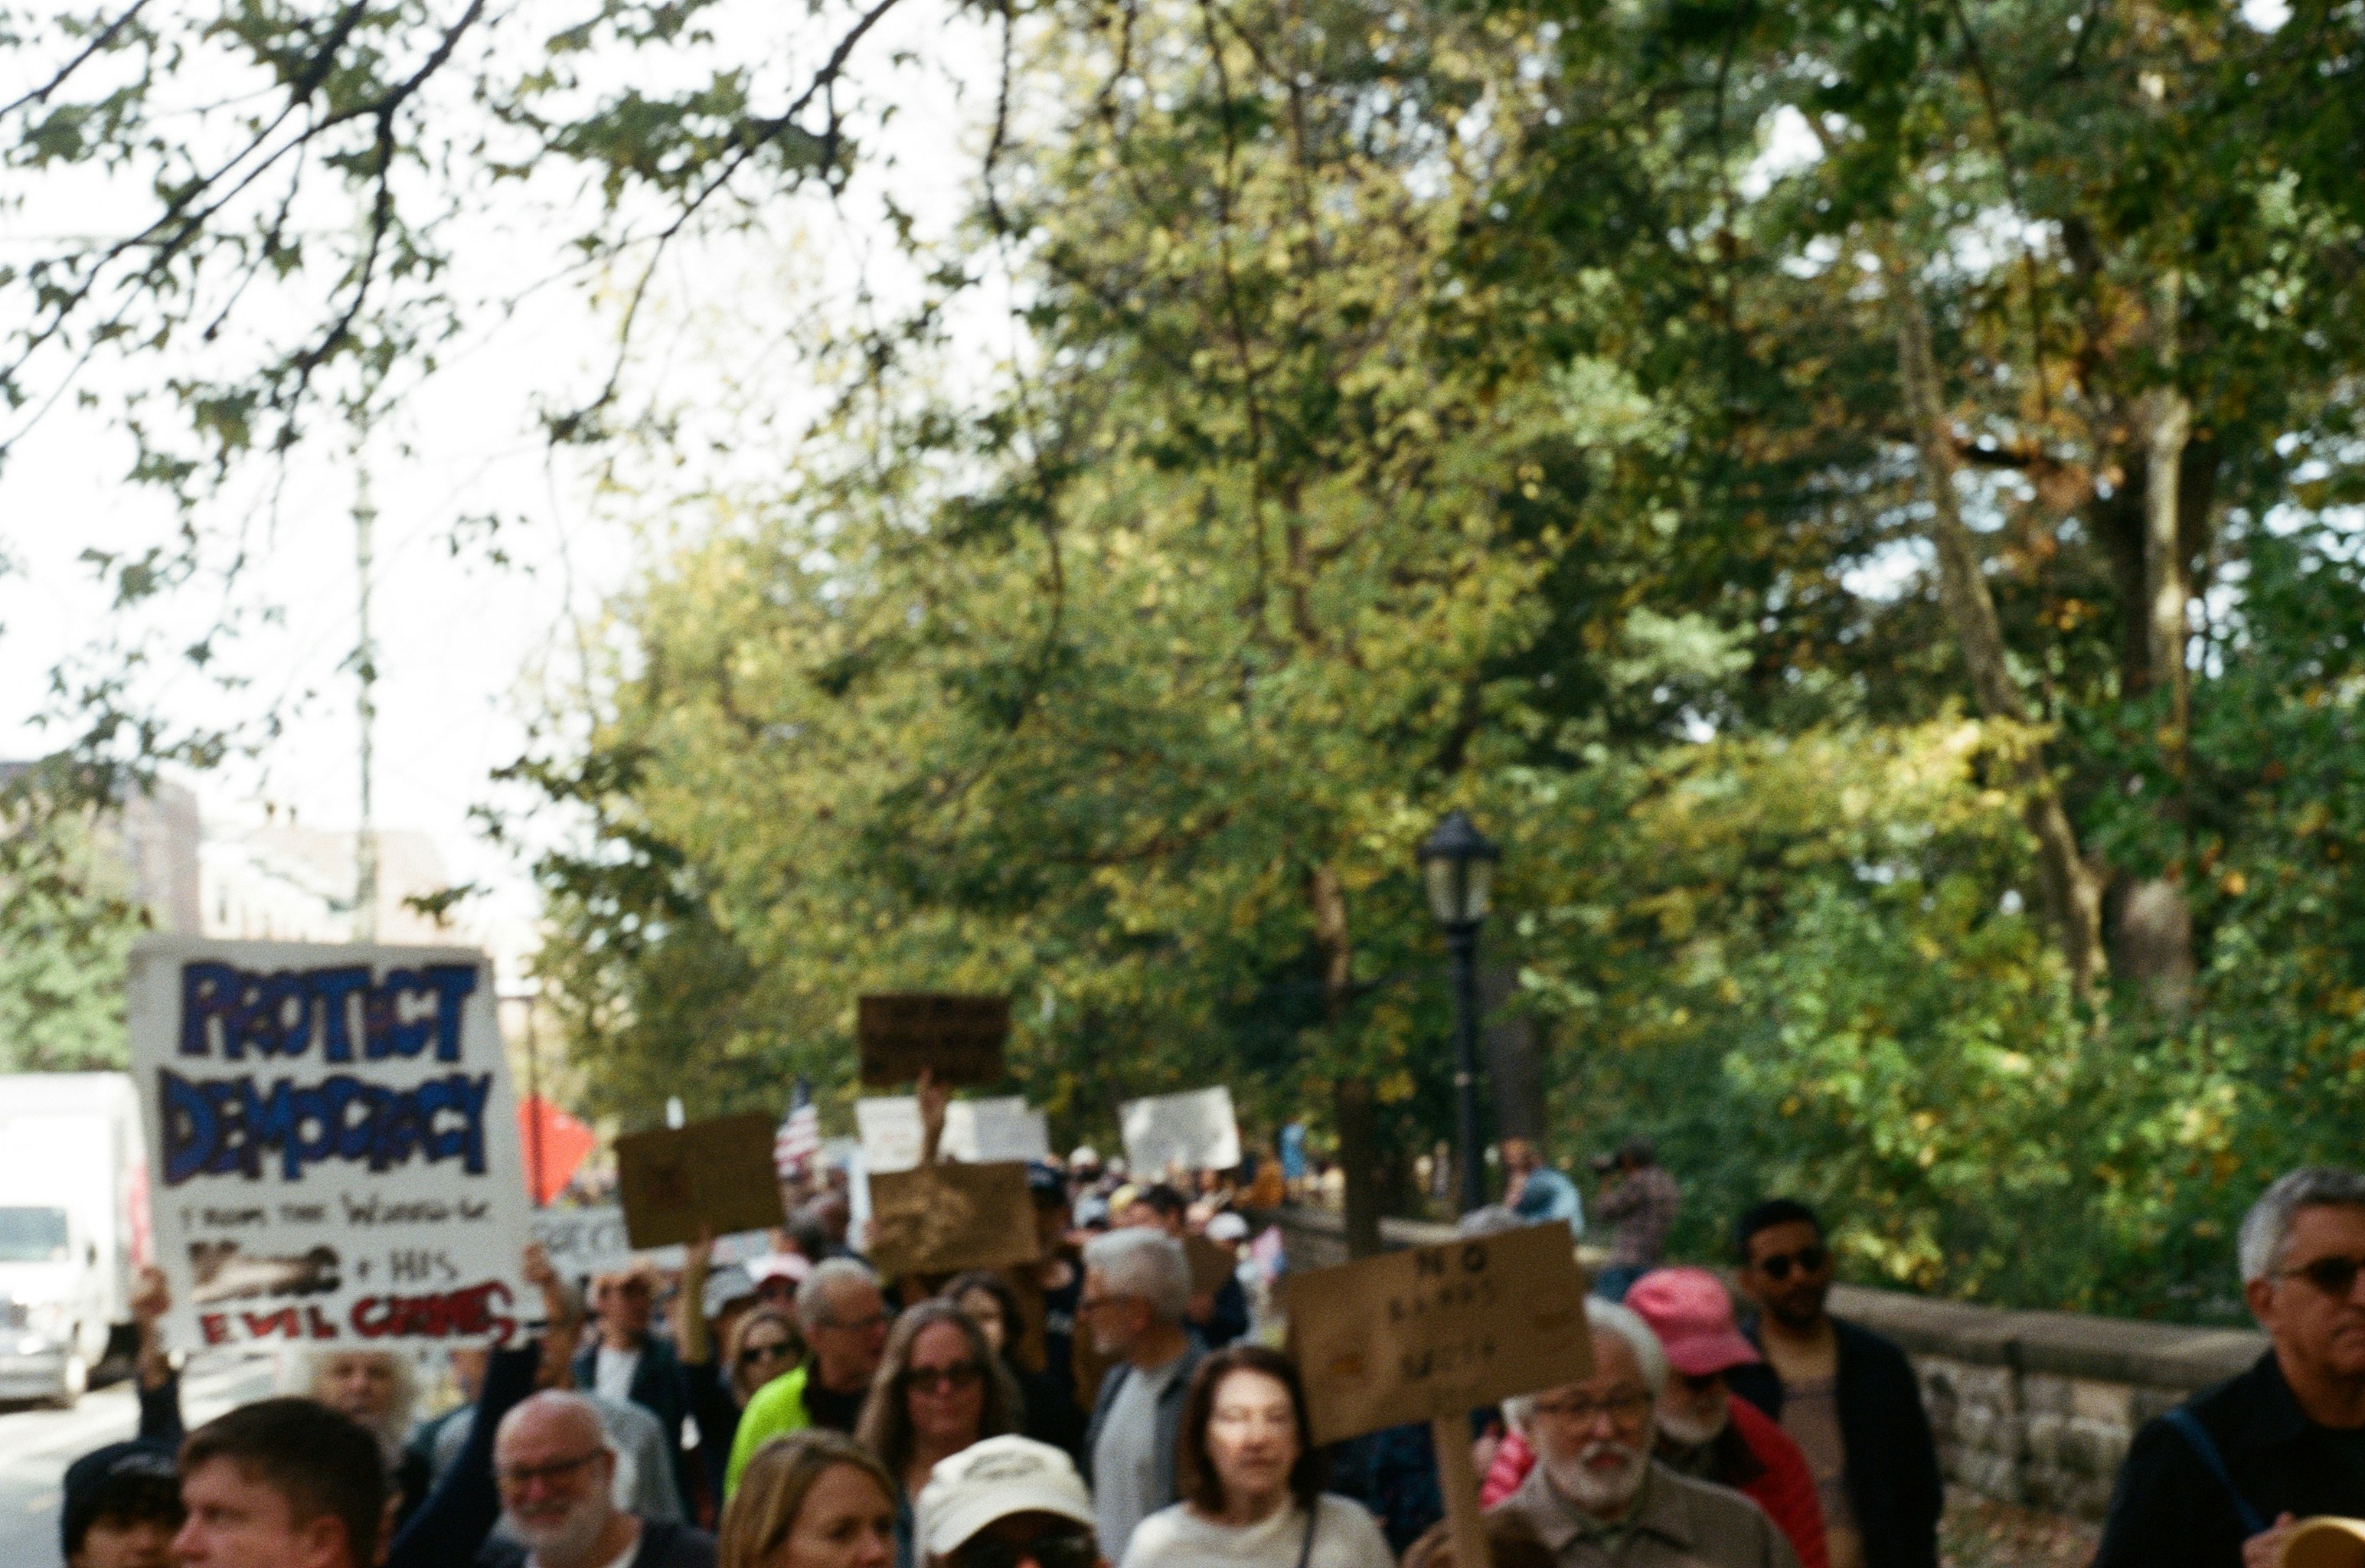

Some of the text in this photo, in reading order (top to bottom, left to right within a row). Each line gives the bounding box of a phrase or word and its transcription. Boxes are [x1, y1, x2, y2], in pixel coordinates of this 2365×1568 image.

[181, 961, 479, 1063] PROTECT
[158, 1067, 493, 1187] DEMOCRACY
[390, 1249, 459, 1283] HIS
[1416, 1243, 1487, 1276] NO
[201, 1305, 338, 1345] EVIL
